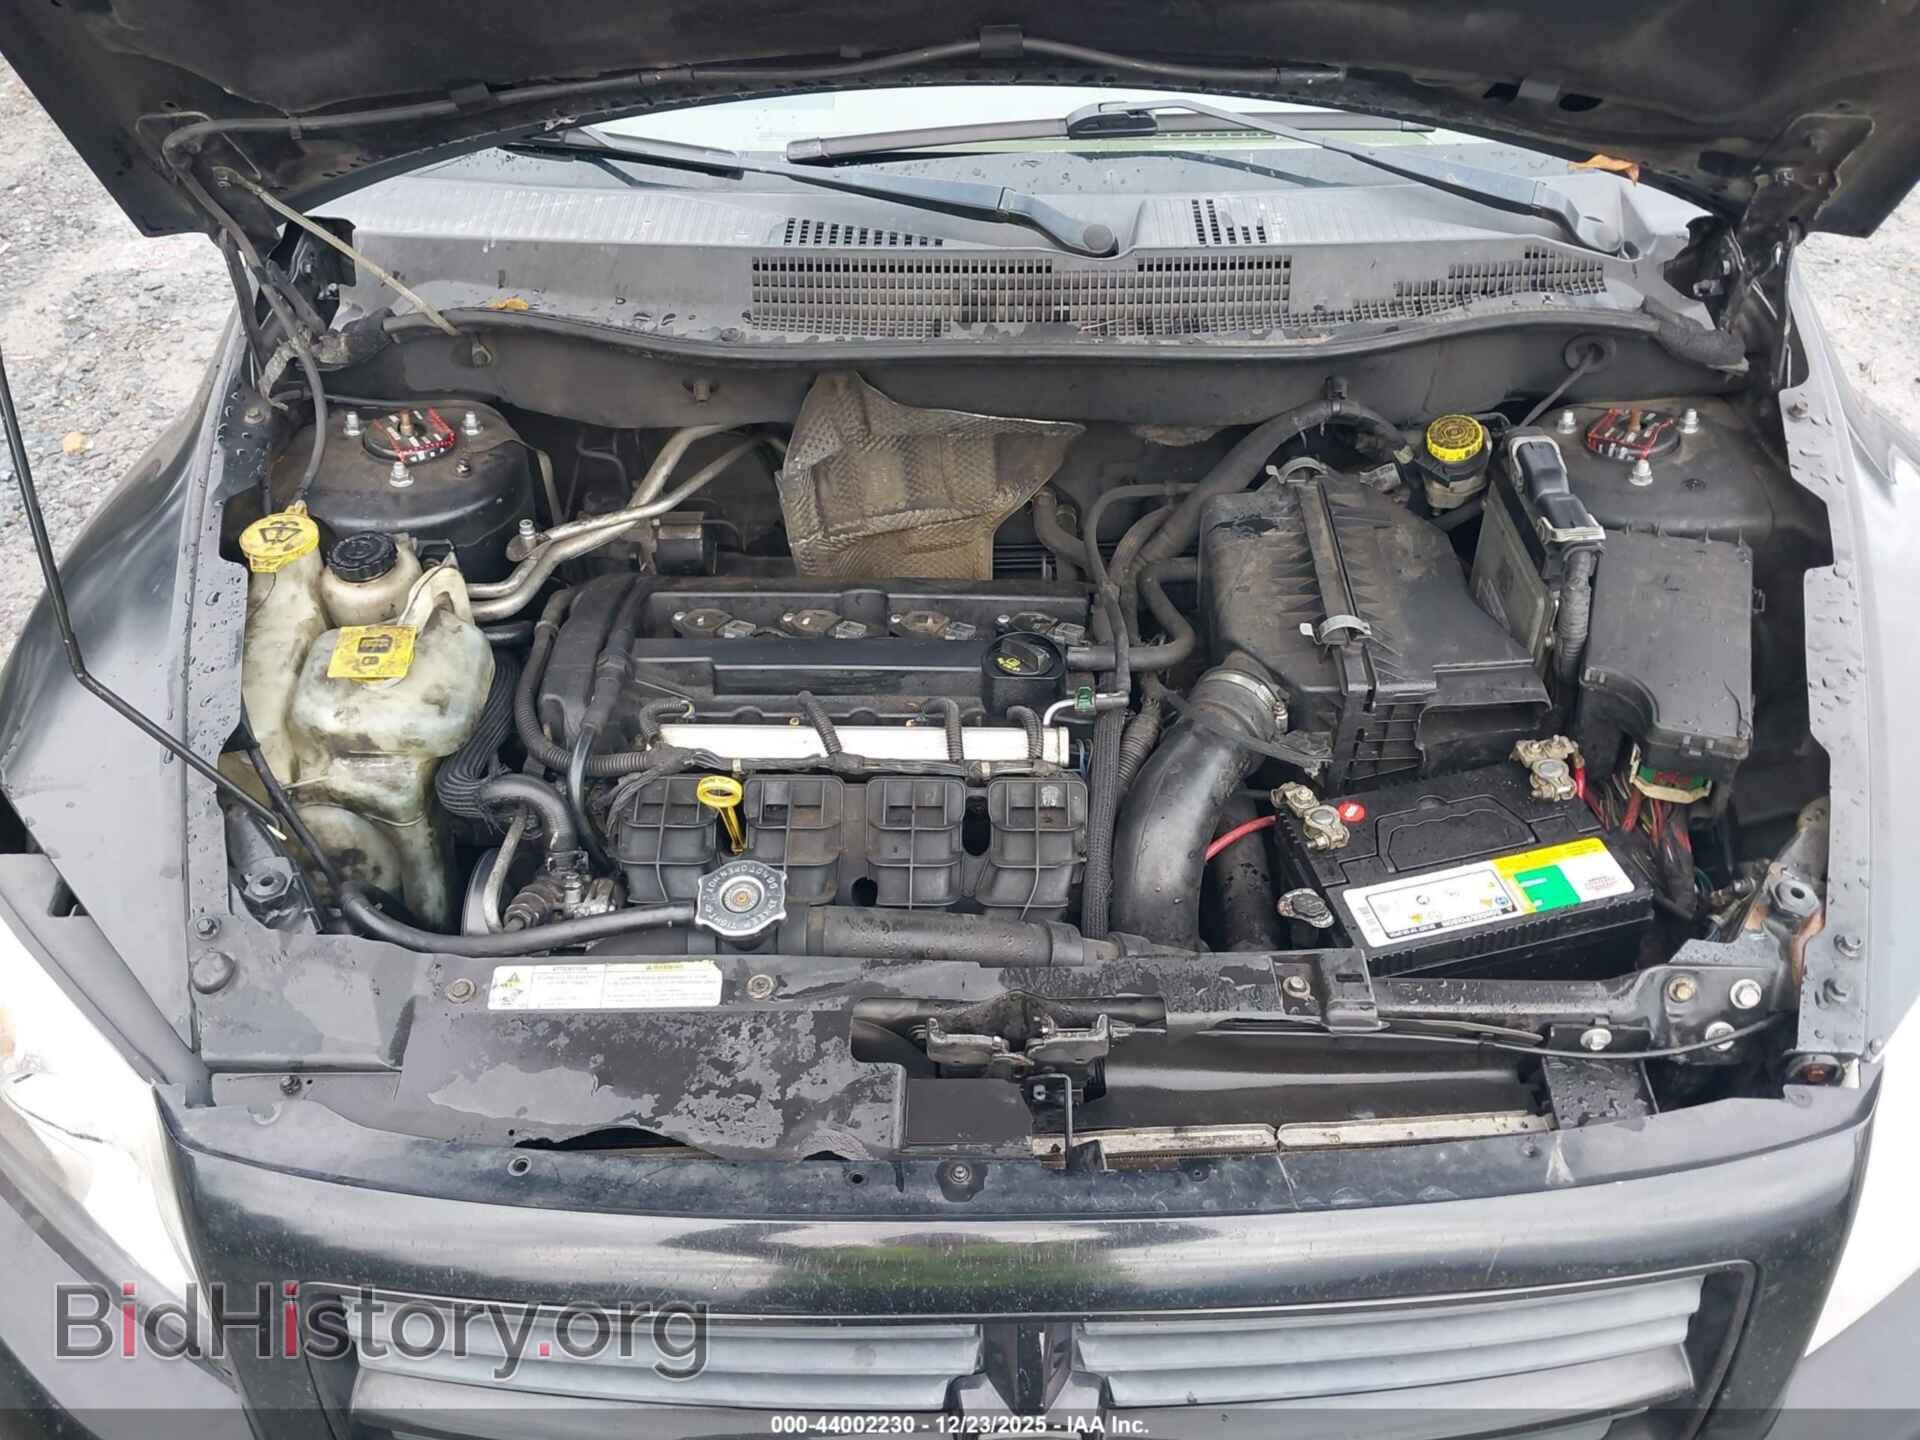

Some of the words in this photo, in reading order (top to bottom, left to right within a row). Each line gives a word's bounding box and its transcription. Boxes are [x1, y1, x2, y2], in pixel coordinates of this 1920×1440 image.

[720, 864, 747, 877] OPEN
[705, 875, 720, 892] HOT
[708, 912, 737, 929] TIGHT
